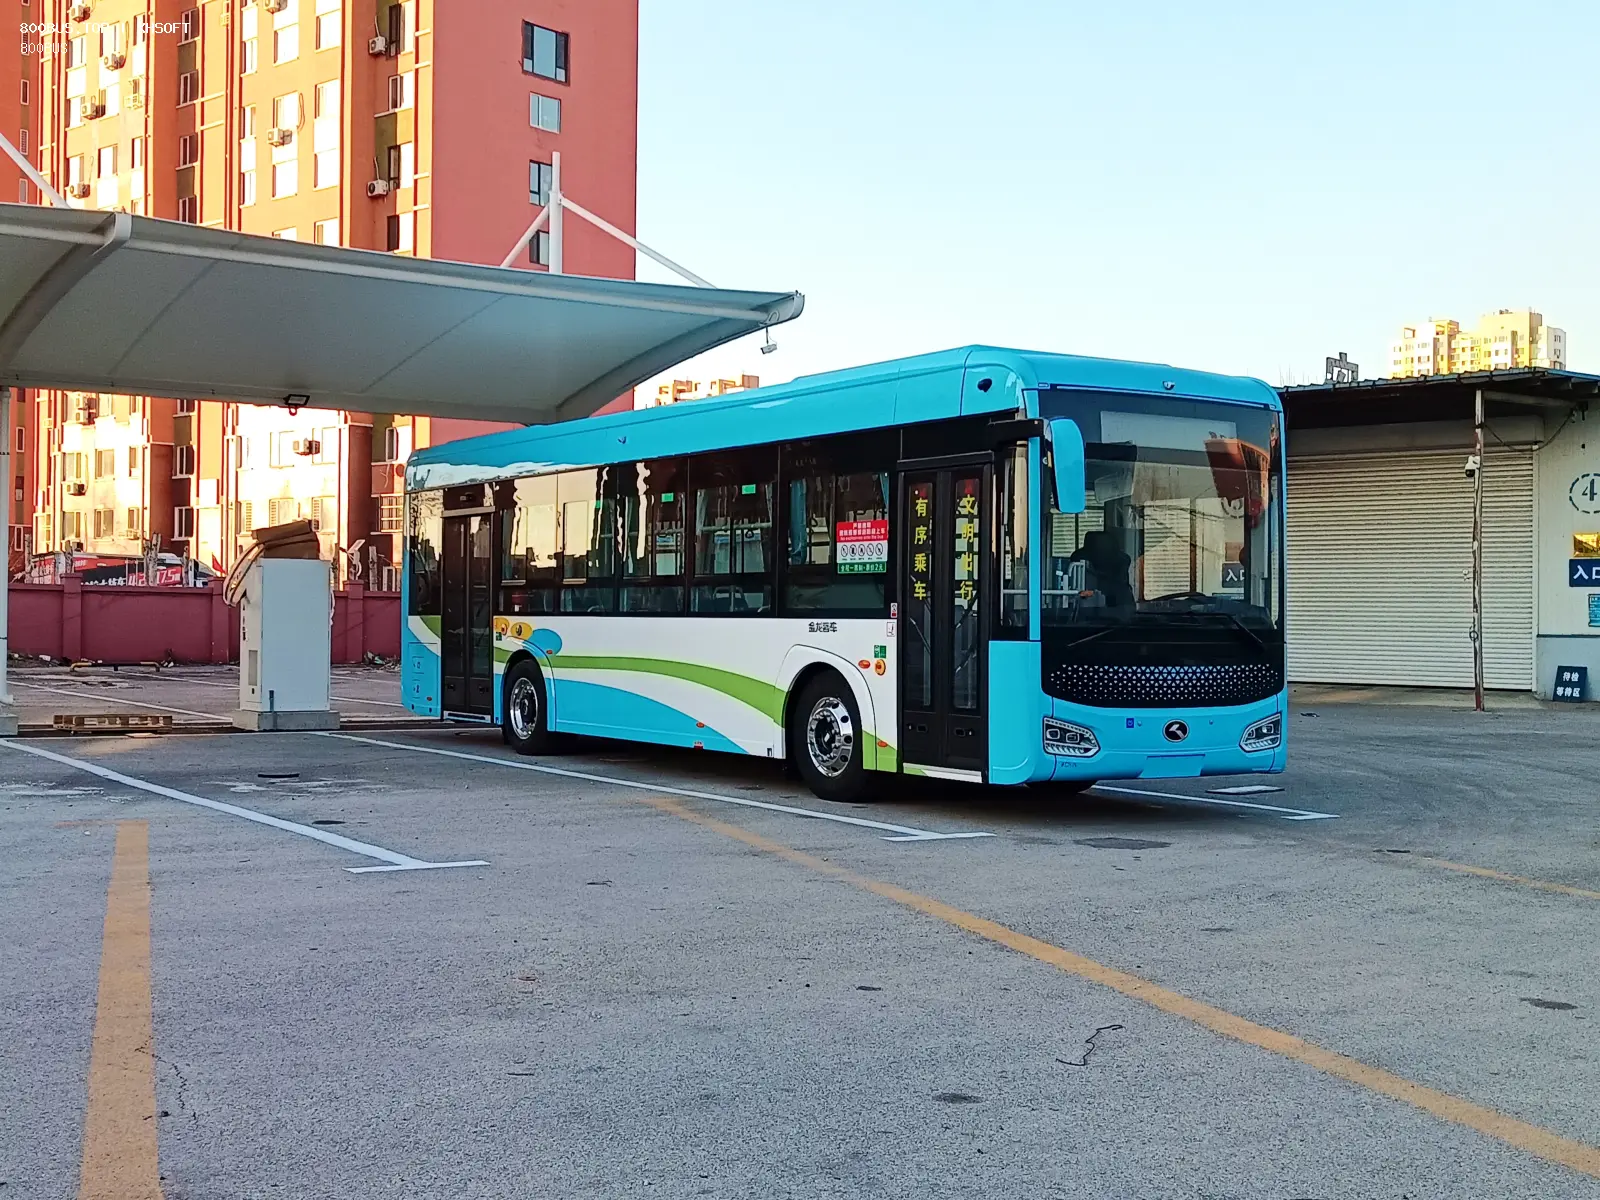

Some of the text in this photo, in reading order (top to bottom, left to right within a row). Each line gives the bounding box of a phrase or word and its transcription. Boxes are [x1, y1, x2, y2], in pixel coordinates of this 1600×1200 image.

[1581, 478, 1598, 501] 4
[914, 497, 928, 600] 有序乘车
[960, 493, 975, 600] 文明出行
[808, 621, 838, 633] 金龙客车
